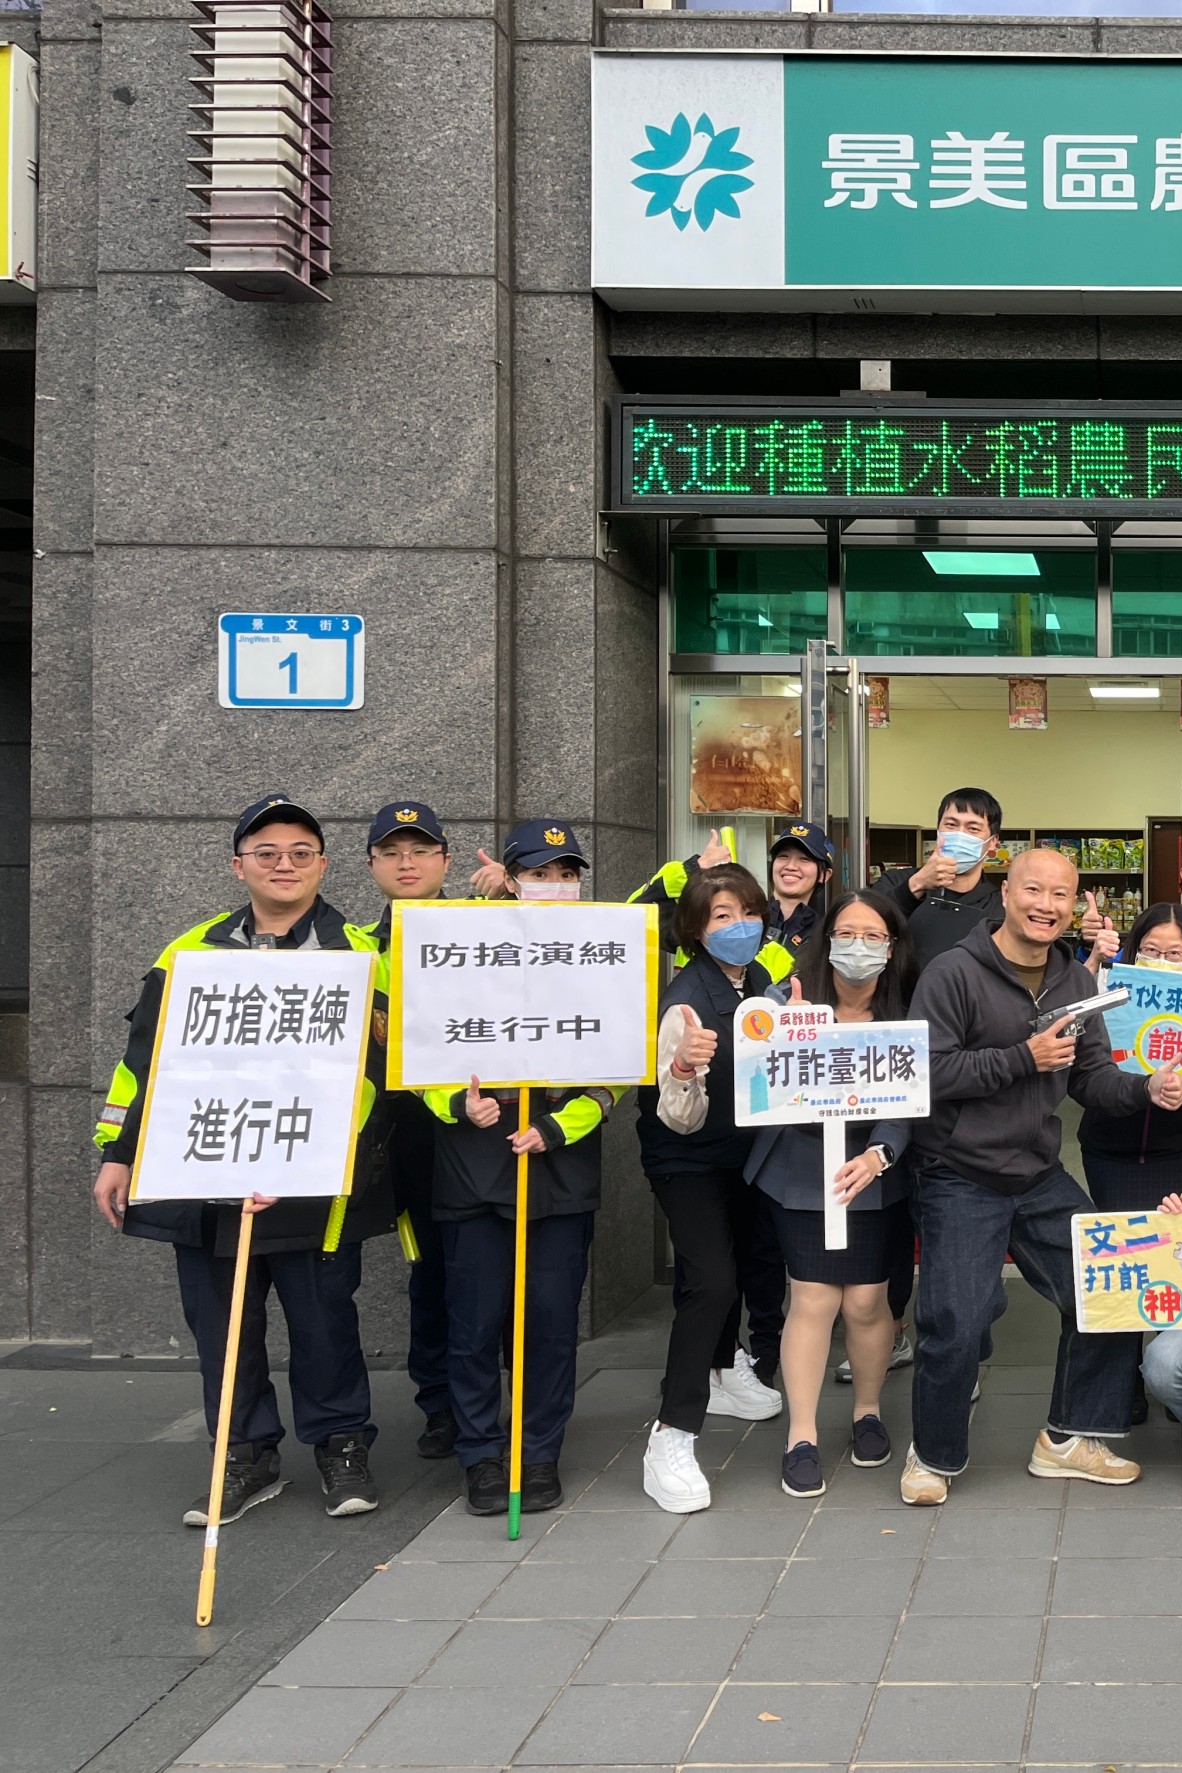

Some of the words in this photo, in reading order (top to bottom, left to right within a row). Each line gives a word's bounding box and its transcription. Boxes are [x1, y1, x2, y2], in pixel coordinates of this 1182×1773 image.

[238, 635, 270, 644] JingWen
[252, 619, 332, 631] 景文街
[341, 620, 350, 631] 3
[279, 652, 298, 694] 1
[420, 941, 627, 968] 防搶演練
[181, 983, 350, 1046] 防搶演練
[445, 1015, 601, 1043] 進行中
[779, 1012, 828, 1026] 反詐請打
[786, 1028, 817, 1042] 165
[766, 1044, 916, 1088] 打詐臺北隊
[183, 1096, 313, 1163] 進行中
[1084, 1215, 1159, 1255] 文二
[1085, 1262, 1150, 1292] 打詐
